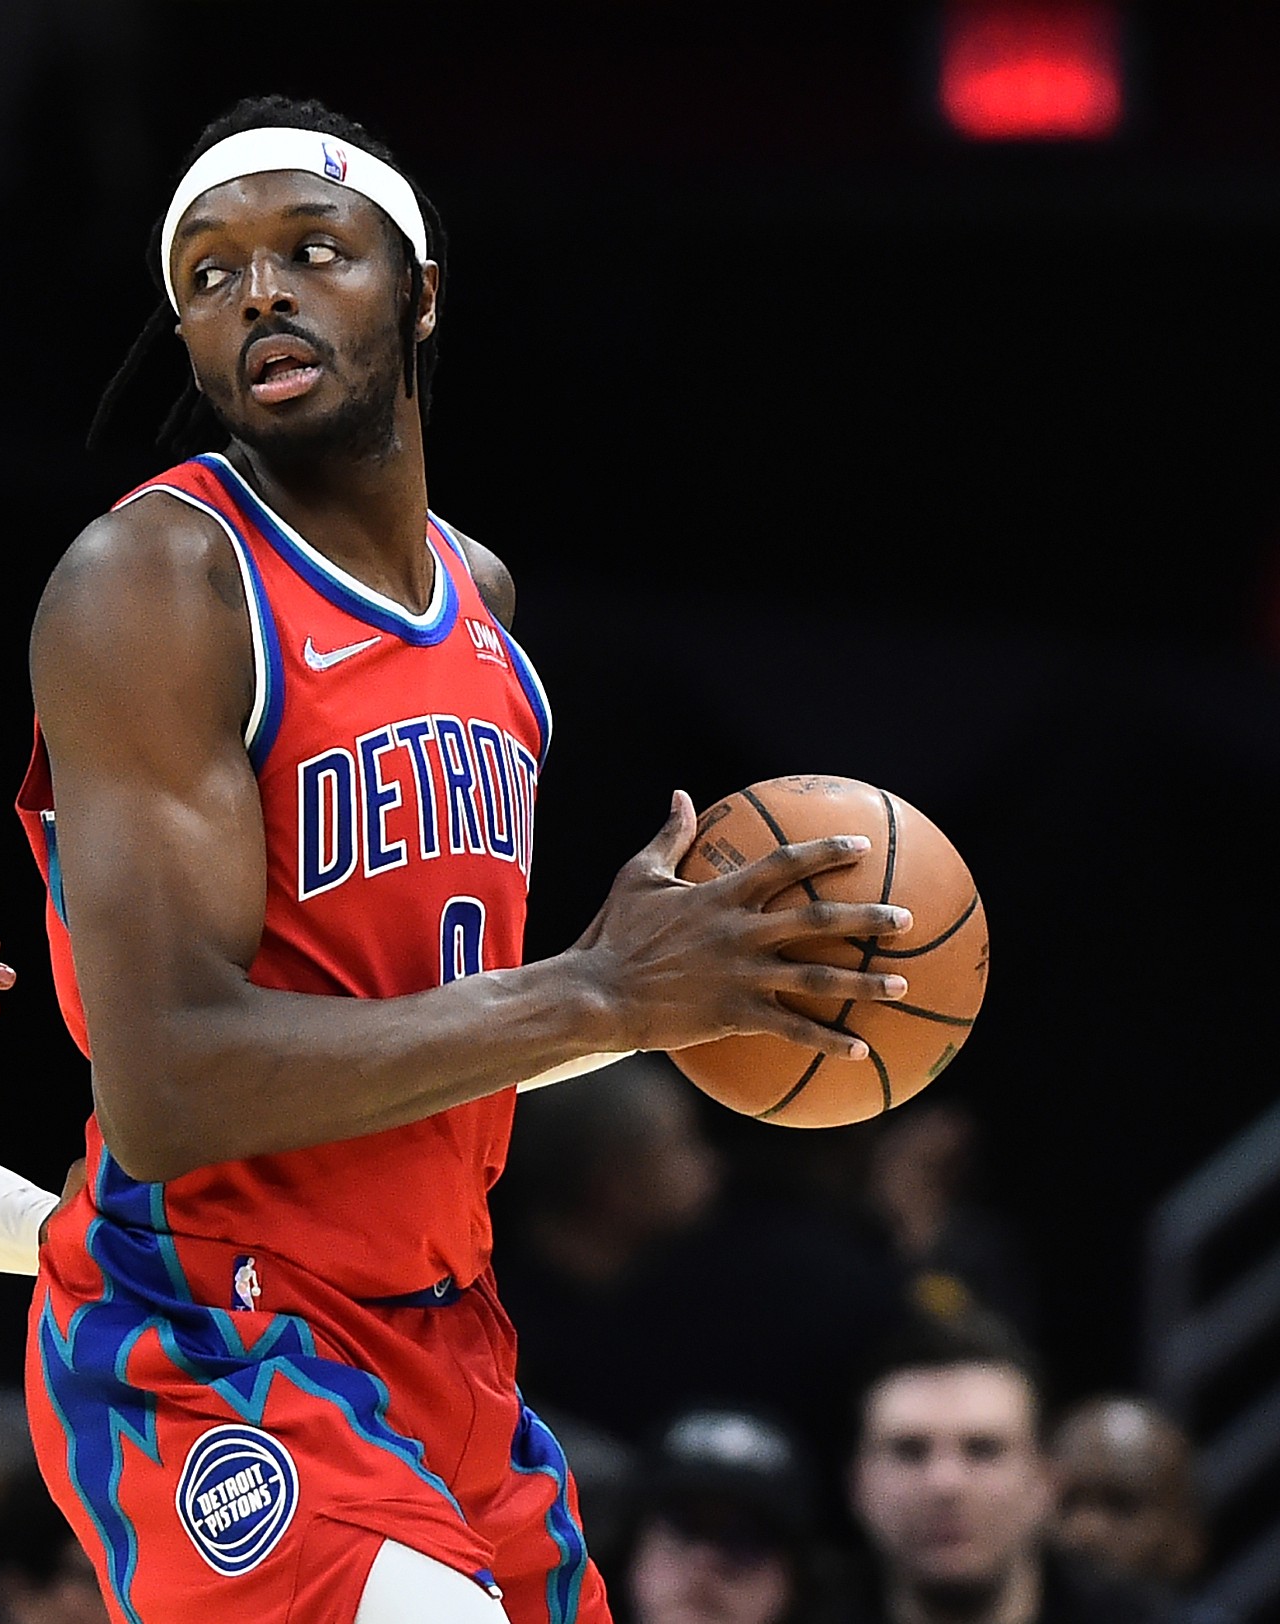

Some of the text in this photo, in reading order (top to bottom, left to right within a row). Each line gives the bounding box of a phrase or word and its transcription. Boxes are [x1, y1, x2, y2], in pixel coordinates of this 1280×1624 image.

[464, 617, 505, 658] UWM
[297, 713, 538, 902] DETROIT
[196, 1462, 264, 1517] DETROIT
[204, 1483, 272, 1538] PISTONS
